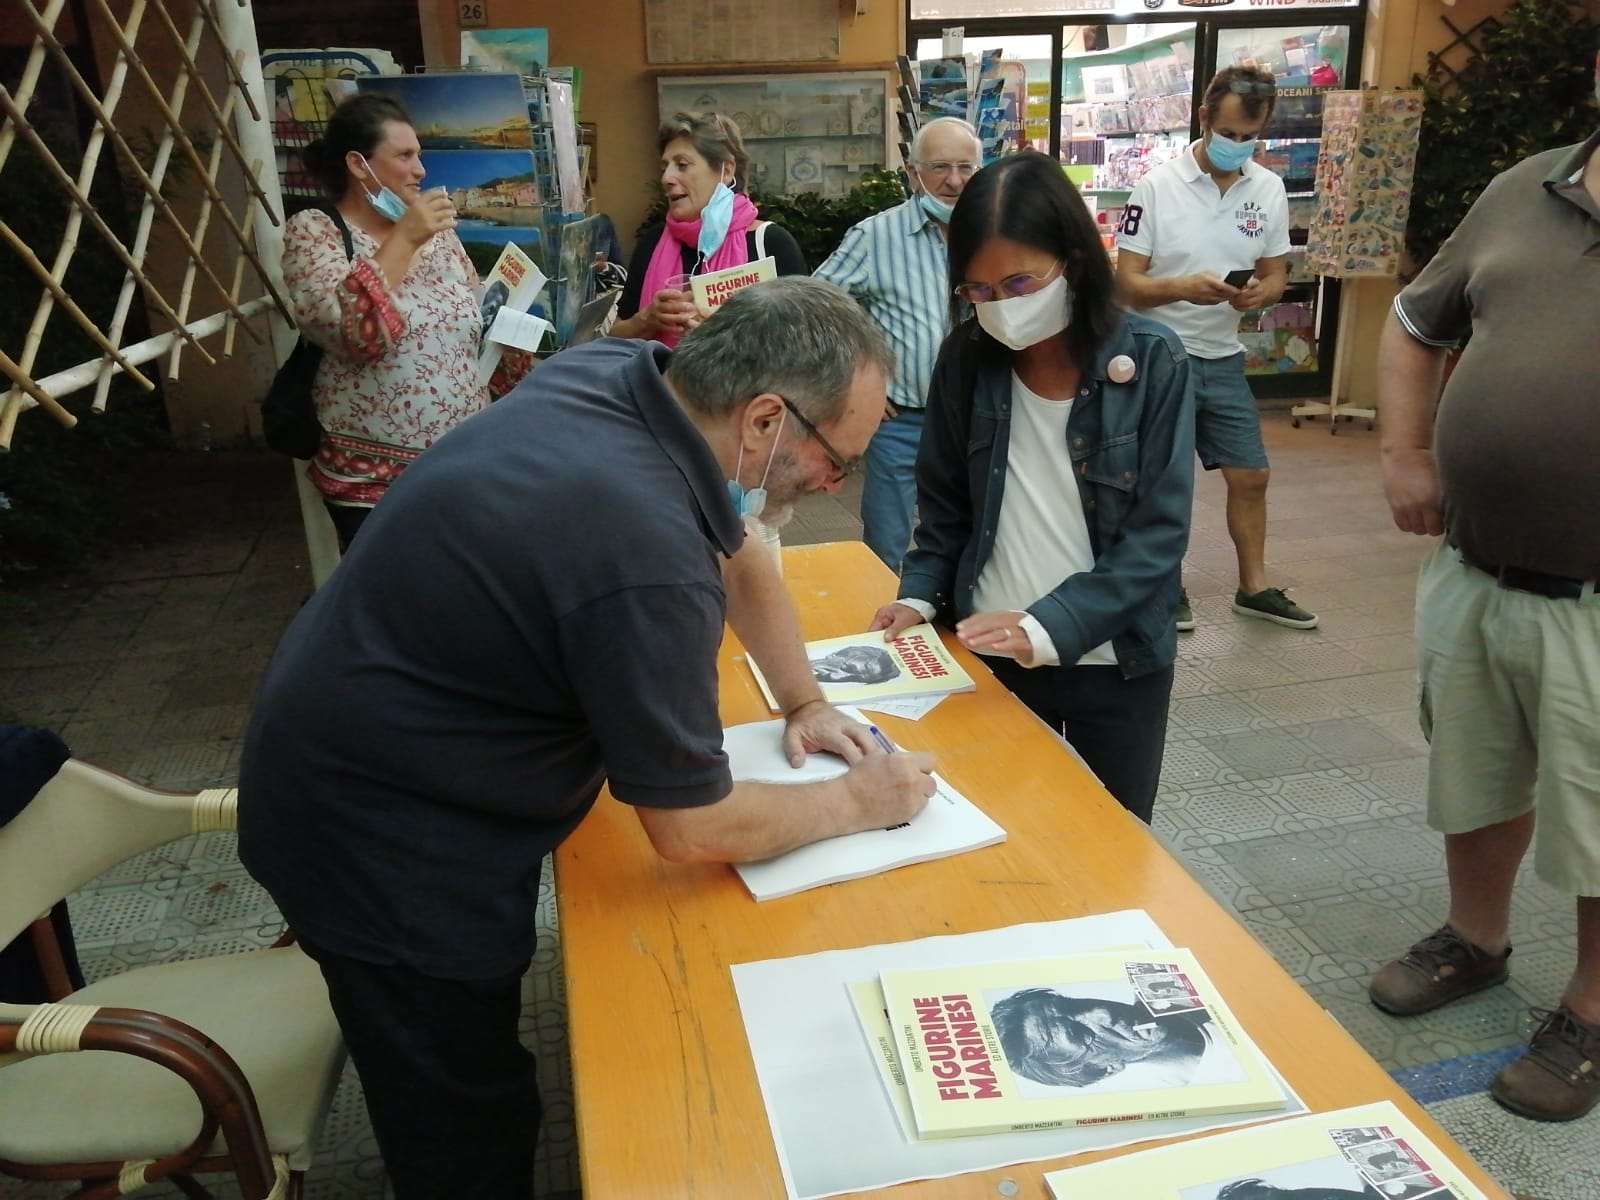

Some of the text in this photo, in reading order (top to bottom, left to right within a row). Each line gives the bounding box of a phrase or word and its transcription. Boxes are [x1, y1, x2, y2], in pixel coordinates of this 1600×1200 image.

[462, 5, 482, 19] 26
[1277, 87, 1313, 97] OCEANI
[1247, 220, 1257, 229] 28
[706, 272, 760, 295] FIGURINE
[892, 637, 932, 680] MARINESI
[908, 635, 949, 677] FIGURINE
[879, 1036, 905, 1086] UMBERTO MAZZANTINI
[904, 1024, 924, 1073] UMBERTO MAZZANTINI
[913, 997, 970, 1101] FIGURINE
[942, 994, 1003, 1099] MARINESI
[1011, 1123, 1034, 1131] UMBERTO
[1035, 1120, 1063, 1129] MAZZANTINI
[1076, 1118, 1109, 1126] FIGURINE
[1110, 1114, 1144, 1122] MARINESI
